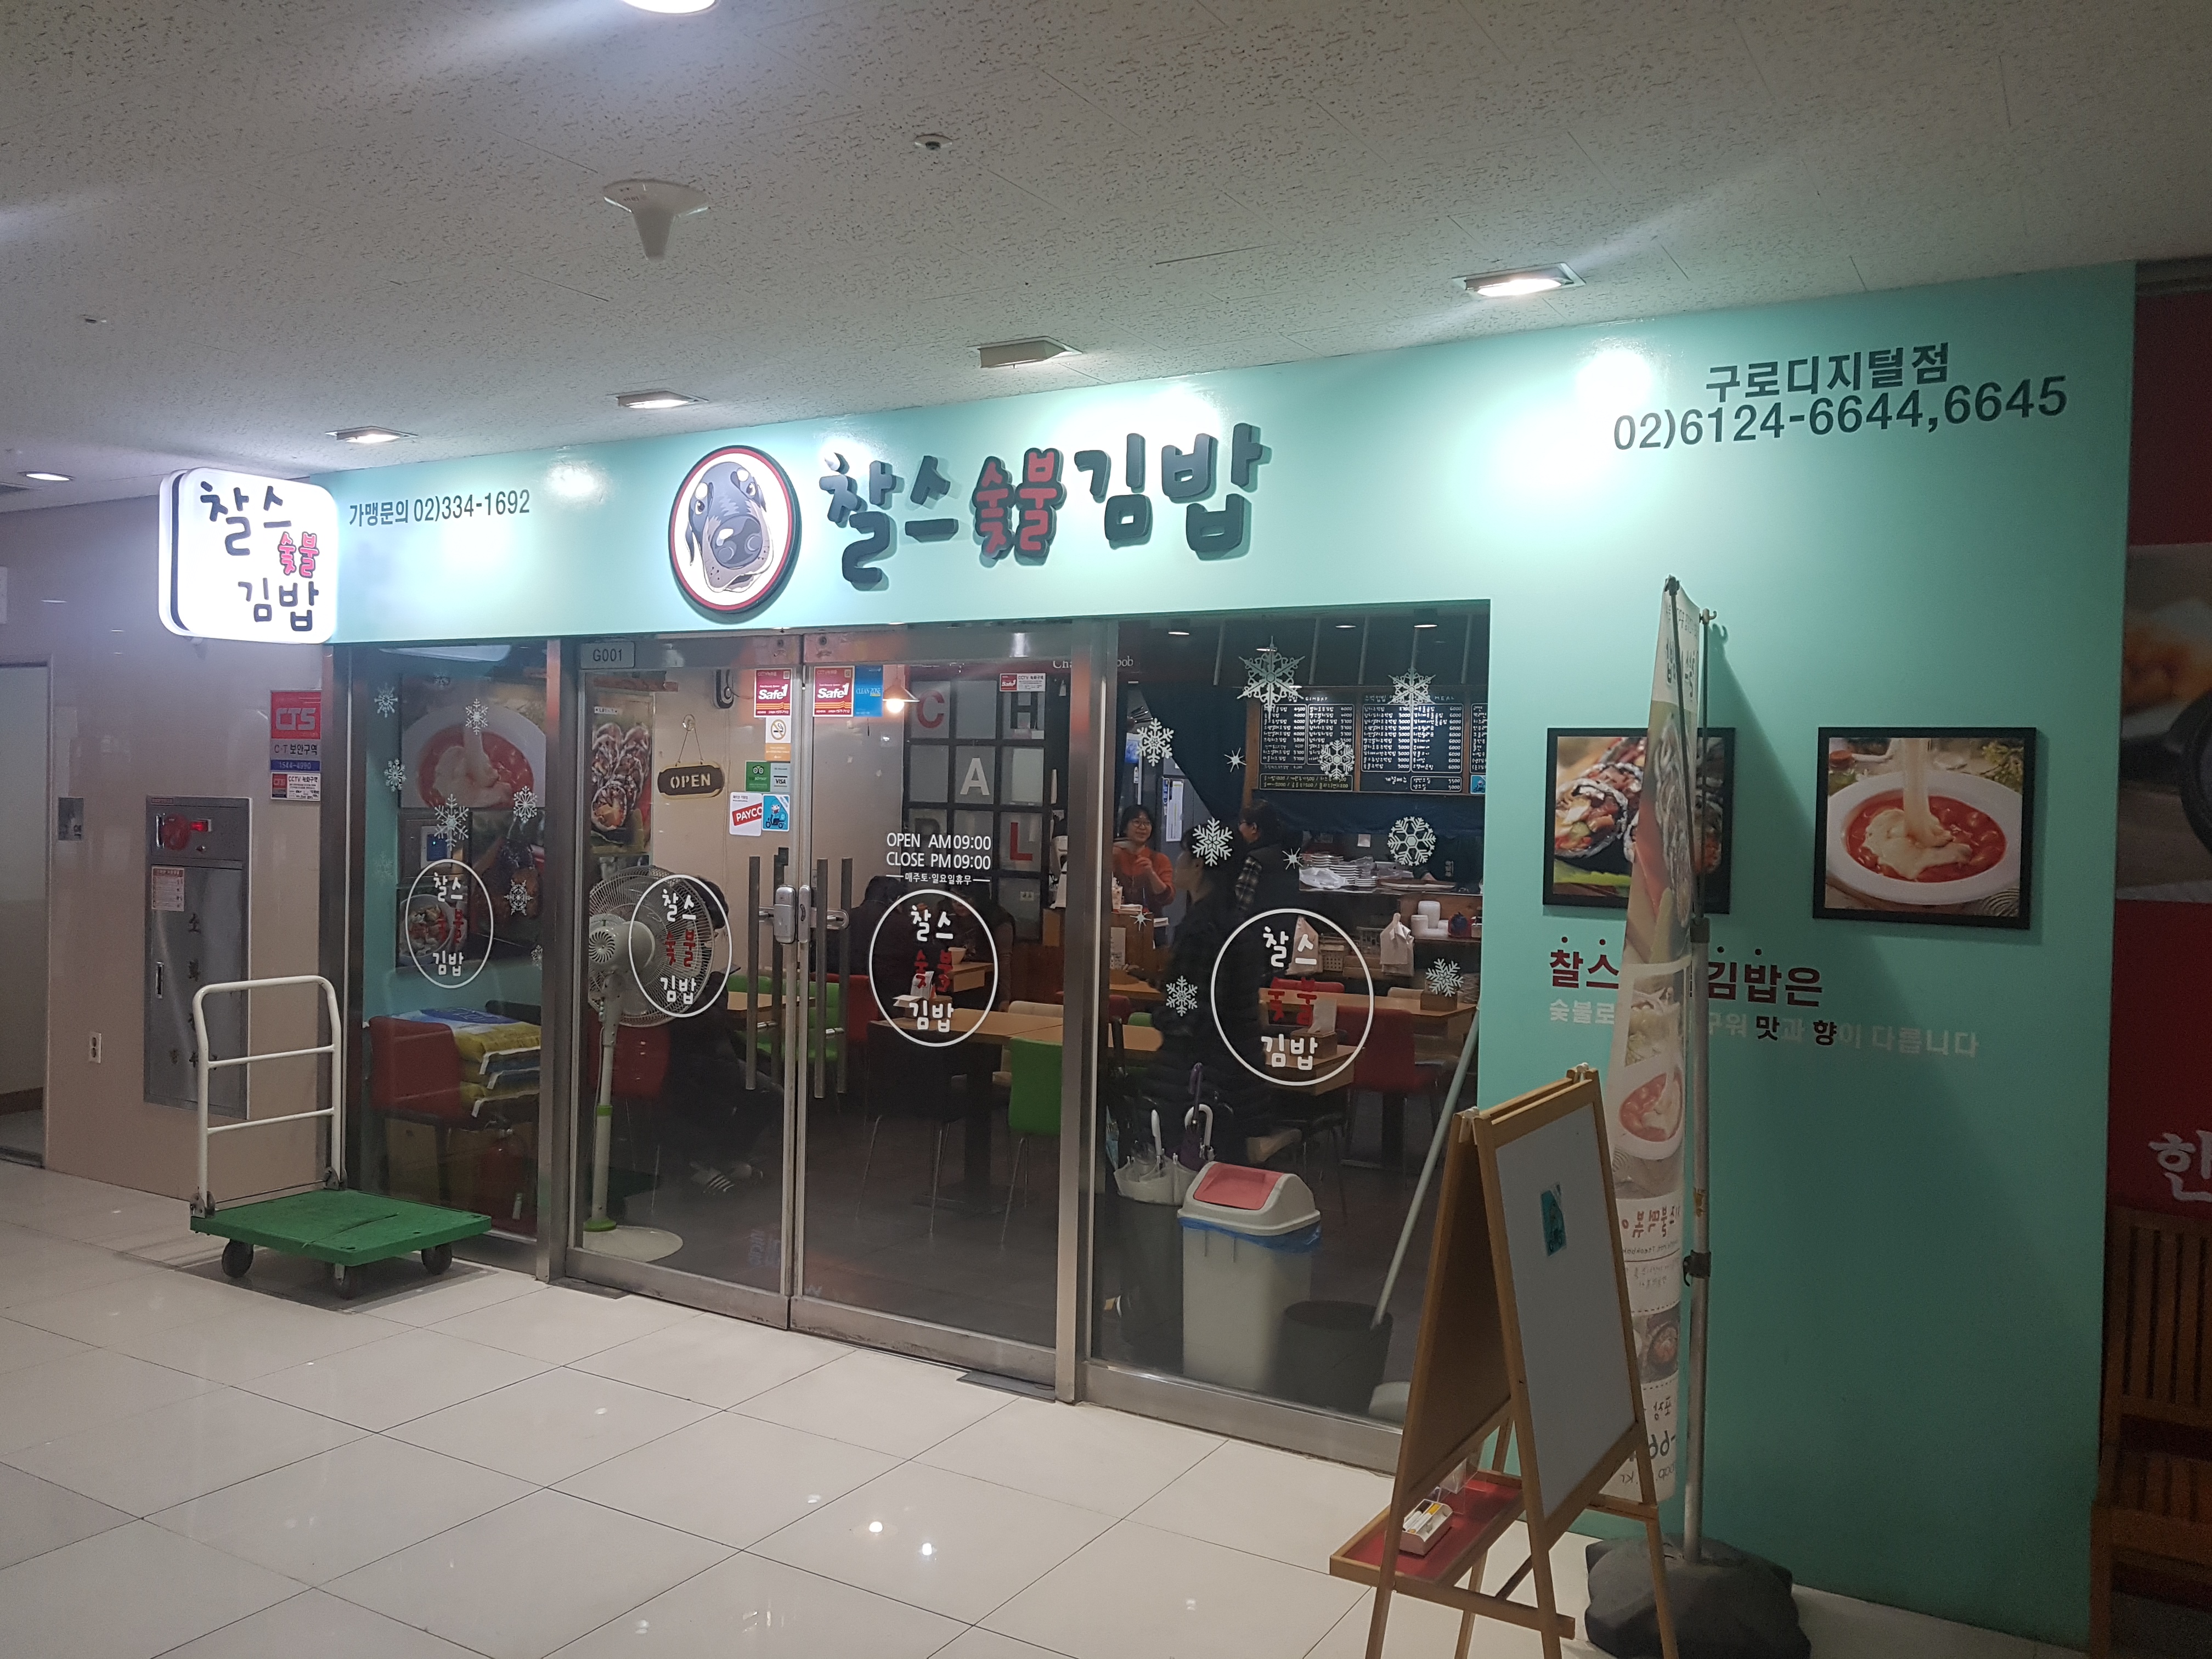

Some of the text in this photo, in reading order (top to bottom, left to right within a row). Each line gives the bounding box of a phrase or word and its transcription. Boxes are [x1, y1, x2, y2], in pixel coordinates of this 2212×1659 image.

[1706, 342, 1949, 402] 구로디지털점
[1613, 375, 2068, 450] 02)6124-6644,6645
[200, 481, 292, 556] 찰스
[349, 489, 531, 527] 가맹문의 02)334-1692
[278, 531, 319, 578] 숯불
[238, 577, 319, 631] 김밥
[592, 648, 623, 662] G001
[290, 744, 318, 755] 보안구역
[670, 773, 712, 789] OPEN
[960, 758, 990, 795] A
[736, 806, 763, 822] PAYCO
[887, 832, 991, 850] OPEN AM 09:00
[1009, 822, 1034, 861] L
[887, 851, 991, 870] CLOSE PM 09:00
[433, 872, 464, 902] 찰스
[662, 889, 696, 923] 찰스
[910, 905, 953, 942] 찰스
[432, 951, 464, 977] 김밥
[1262, 926, 1318, 968] 찰스
[660, 975, 697, 1005] 김밥
[908, 1000, 955, 1034] 김밥
[1755, 1015, 1805, 1045] 맛과
[1261, 1034, 1318, 1071] 김밥
